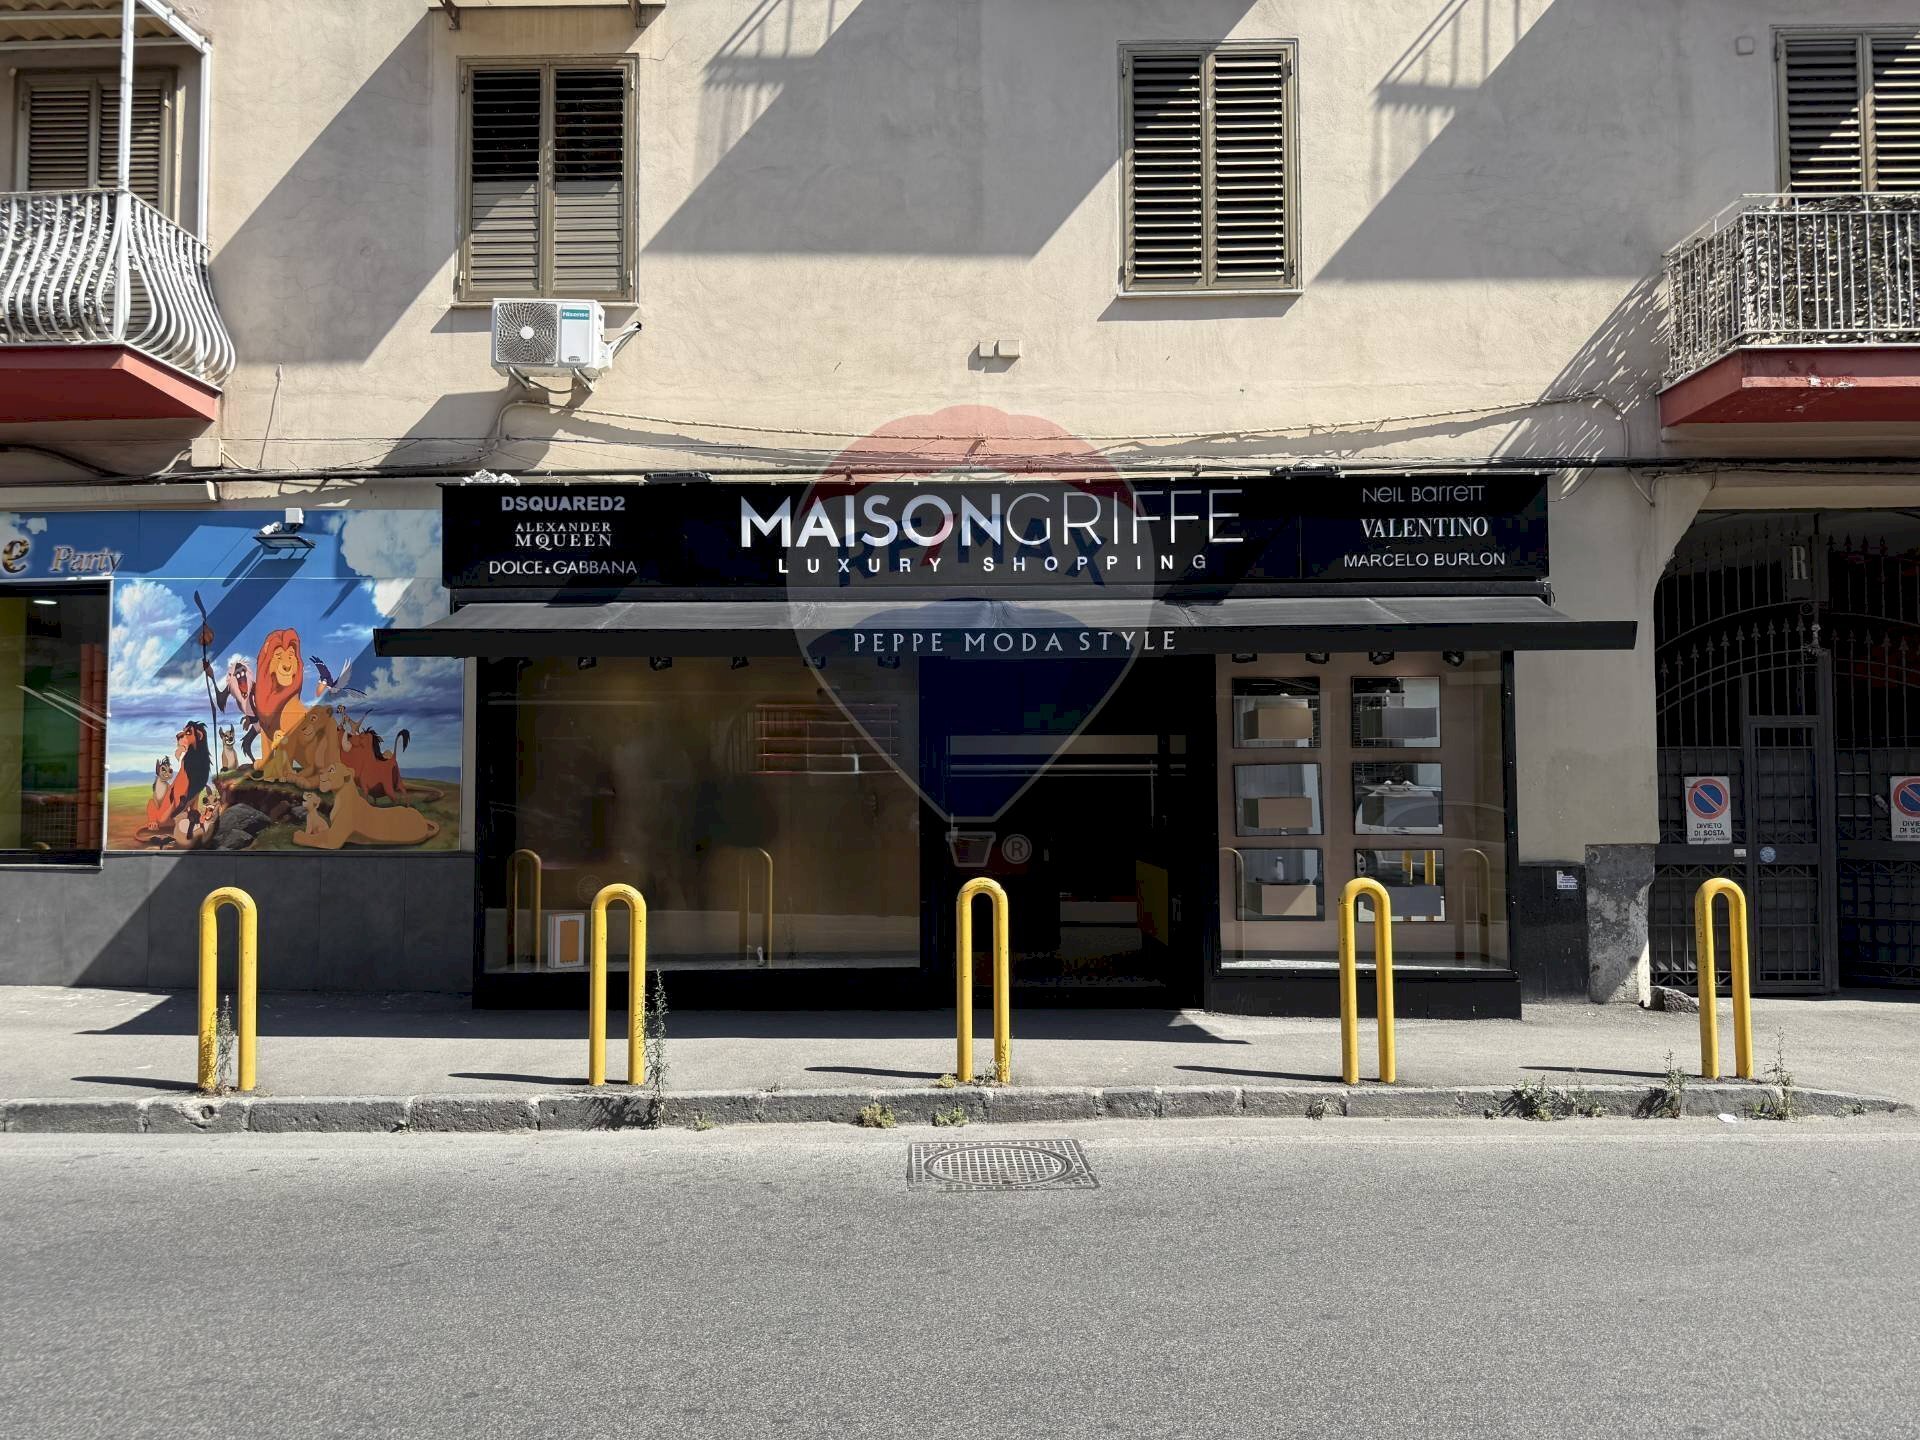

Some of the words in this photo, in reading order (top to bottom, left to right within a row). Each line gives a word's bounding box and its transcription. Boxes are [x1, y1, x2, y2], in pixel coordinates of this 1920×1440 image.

[501, 496, 625, 511] DSQUARED2
[515, 522, 612, 532] ALEXANDER
[740, 489, 1244, 548] MAISONGRIFFE
[1360, 516, 1489, 538] VALENTINO
[49, 547, 126, 576] Party
[778, 557, 941, 574] LUXURY
[983, 554, 1206, 572] SHOPPING
[1344, 553, 1429, 568] MARCELO
[1434, 552, 1505, 566] BURLON
[853, 633, 942, 653] PEPPE
[964, 632, 1063, 652] MODA
[1079, 630, 1176, 651] STYLE
[1703, 829, 1725, 837] SOSTA
